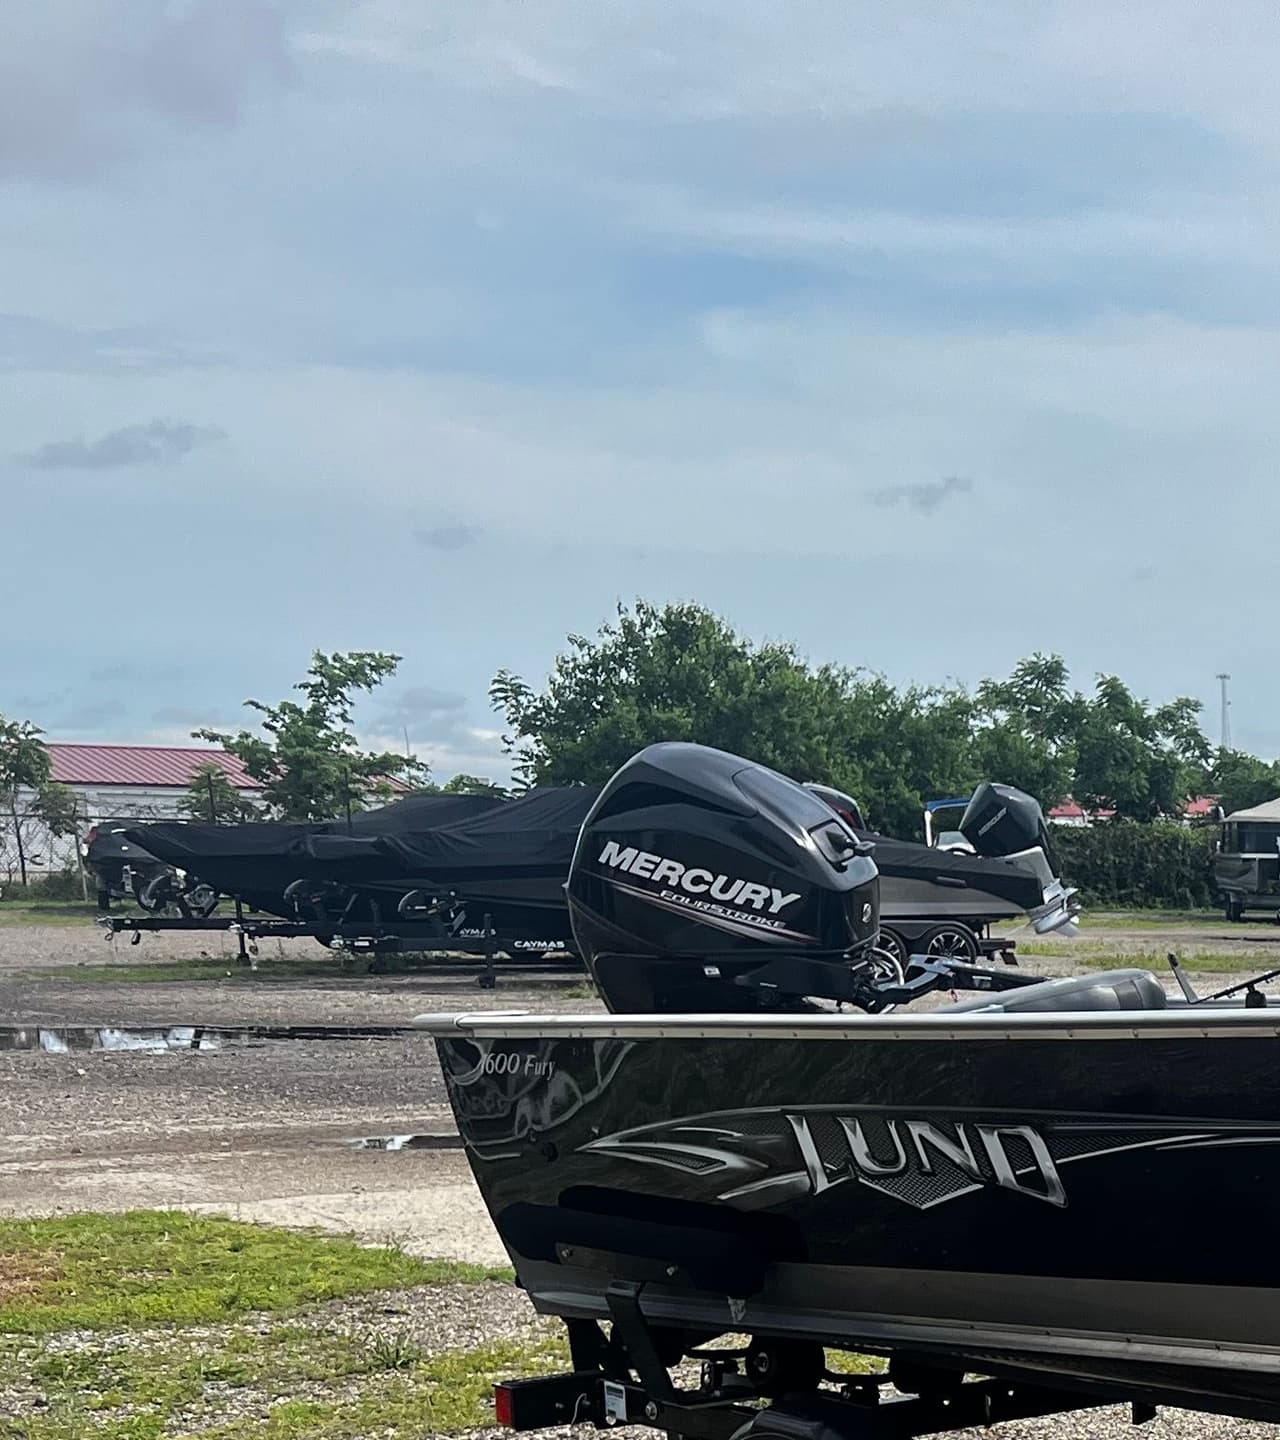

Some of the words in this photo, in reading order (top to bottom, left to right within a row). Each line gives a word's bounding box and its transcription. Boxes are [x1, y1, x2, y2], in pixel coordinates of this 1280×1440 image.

[598, 841, 801, 914] MERCURY
[660, 889, 786, 929] FOURSTROKE
[513, 940, 565, 949] CAYMAS
[480, 1053, 520, 1074] 1600
[524, 1054, 556, 1081] Fury
[786, 1114, 1069, 1208] LUND
